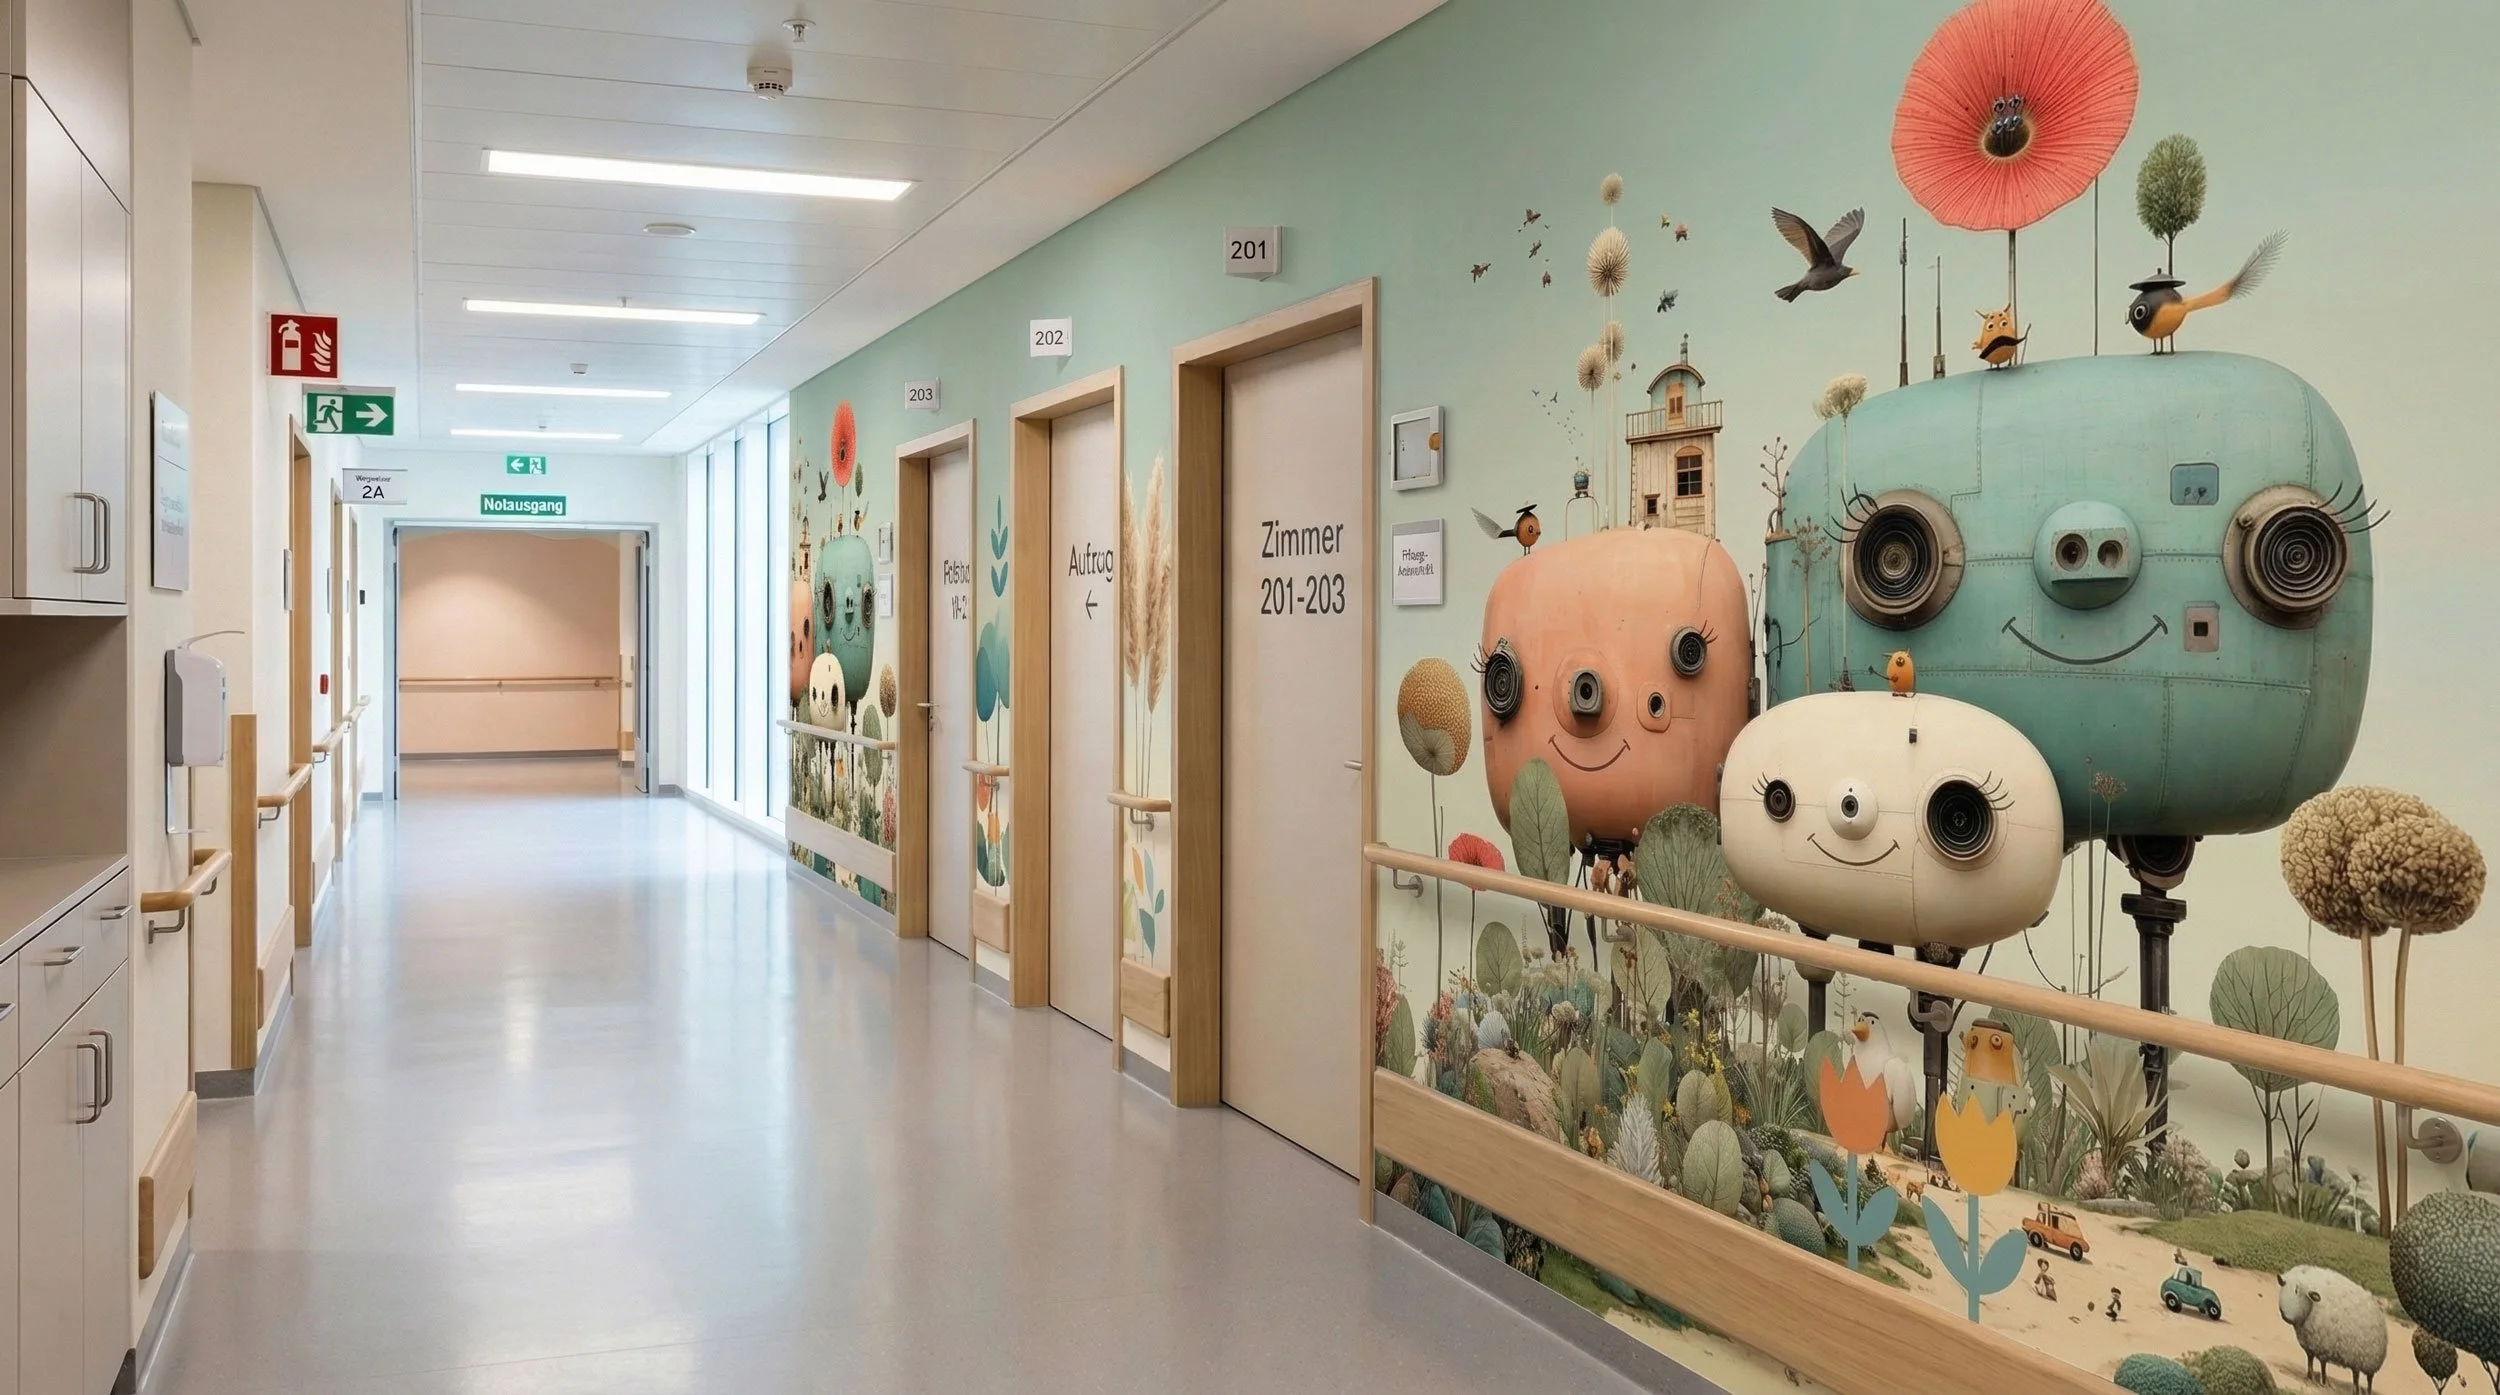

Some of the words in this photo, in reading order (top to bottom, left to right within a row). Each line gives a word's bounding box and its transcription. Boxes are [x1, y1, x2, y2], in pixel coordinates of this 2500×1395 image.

[1231, 240, 1266, 260] 201
[1035, 329, 1064, 346] 202
[909, 387, 934, 402] 203
[362, 485, 385, 499] 2A
[1261, 520, 1344, 558] Zimmer
[1260, 573, 1346, 615] 201-203
